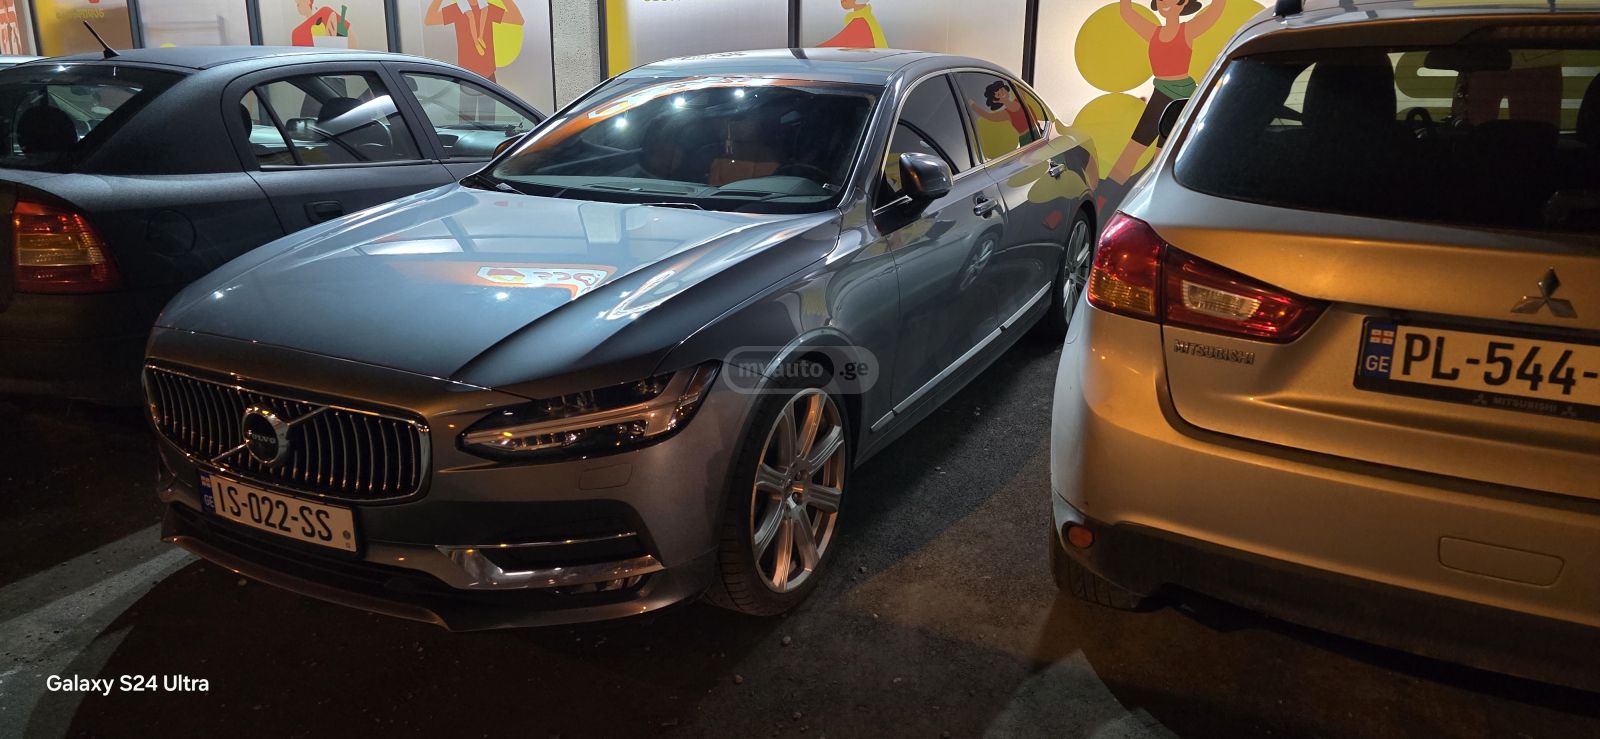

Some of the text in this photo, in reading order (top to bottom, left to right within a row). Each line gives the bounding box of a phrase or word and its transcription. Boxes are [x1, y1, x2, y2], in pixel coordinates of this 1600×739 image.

[1174, 339, 1256, 365] MITSUBISHI
[1365, 354, 1391, 373] GE
[1401, 332, 1599, 396] PL-544-
[1492, 397, 1558, 413] MITSUBISHI
[217, 481, 333, 542] IS-022-SS
